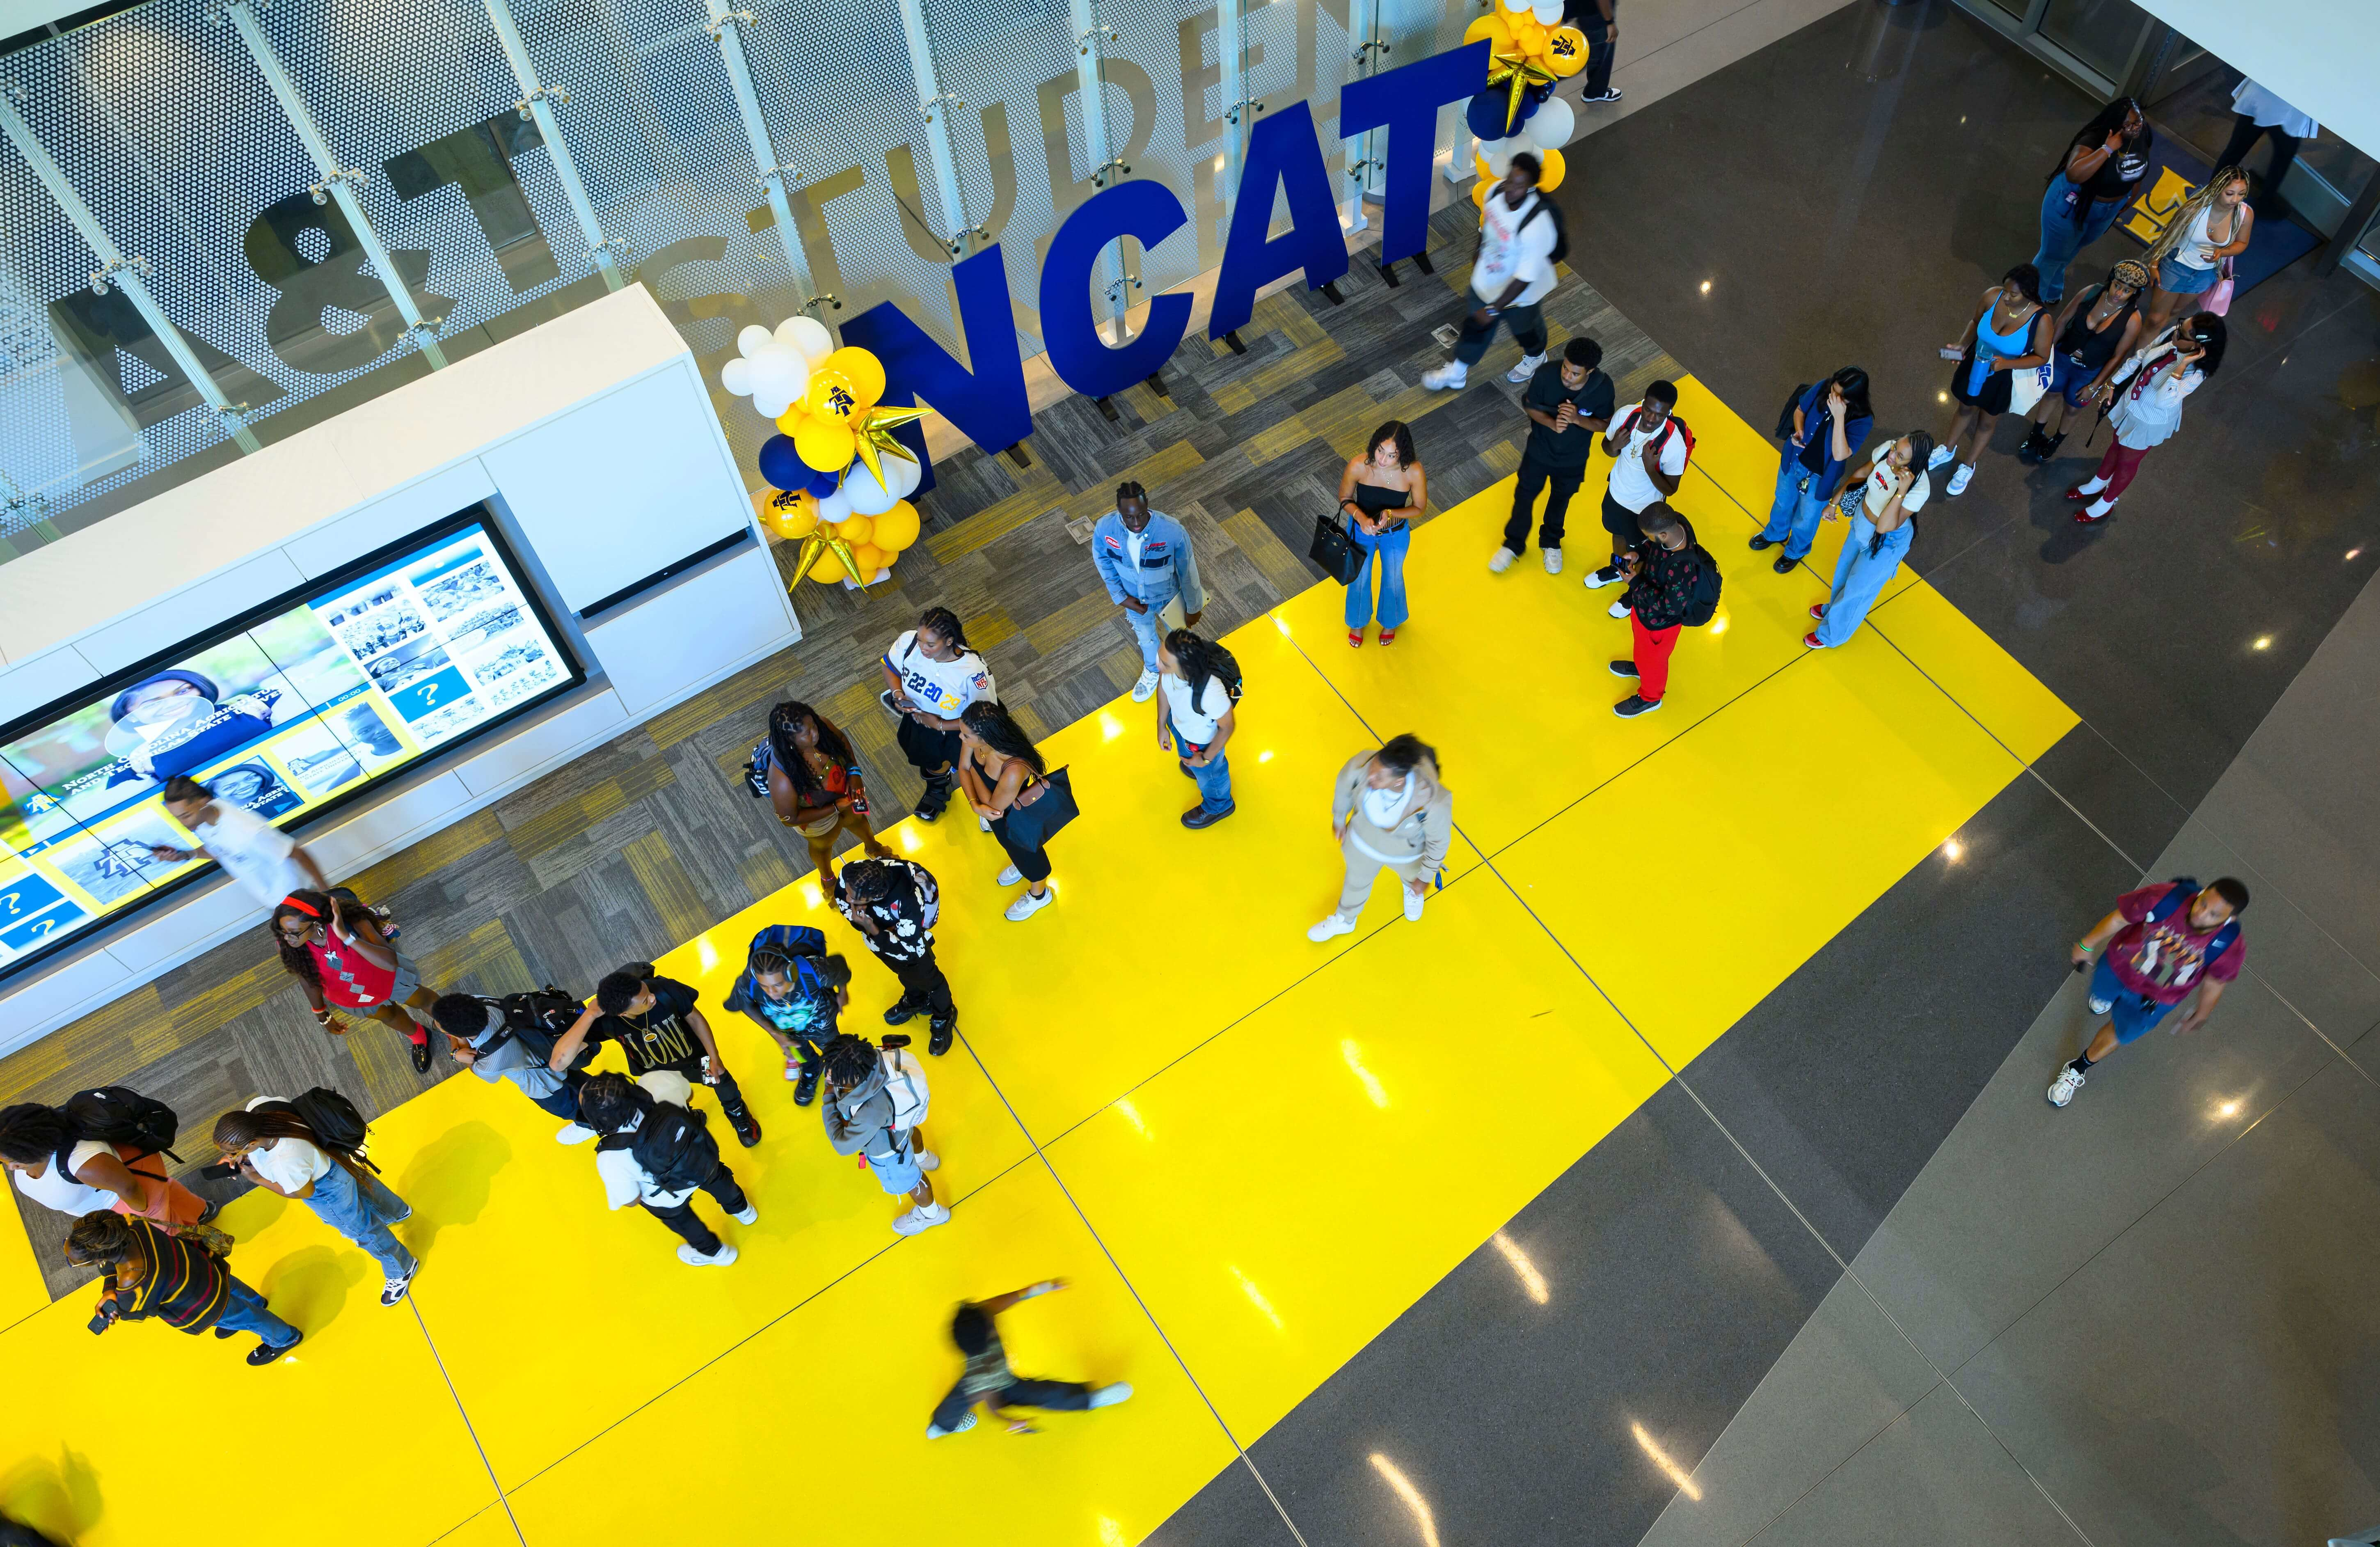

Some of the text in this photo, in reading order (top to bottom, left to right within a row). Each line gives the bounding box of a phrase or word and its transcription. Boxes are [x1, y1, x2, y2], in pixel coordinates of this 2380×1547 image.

[46, 107, 562, 486] A&T
[839, 38, 1492, 505] NCAT
[337, 688, 361, 701] 00:00
[907, 672, 926, 694] 22
[924, 682, 943, 703] 20
[939, 693, 960, 710] 29
[62, 763, 116, 791] NORTH
[117, 727, 192, 763] COLINA
[71, 777, 101, 796] AND
